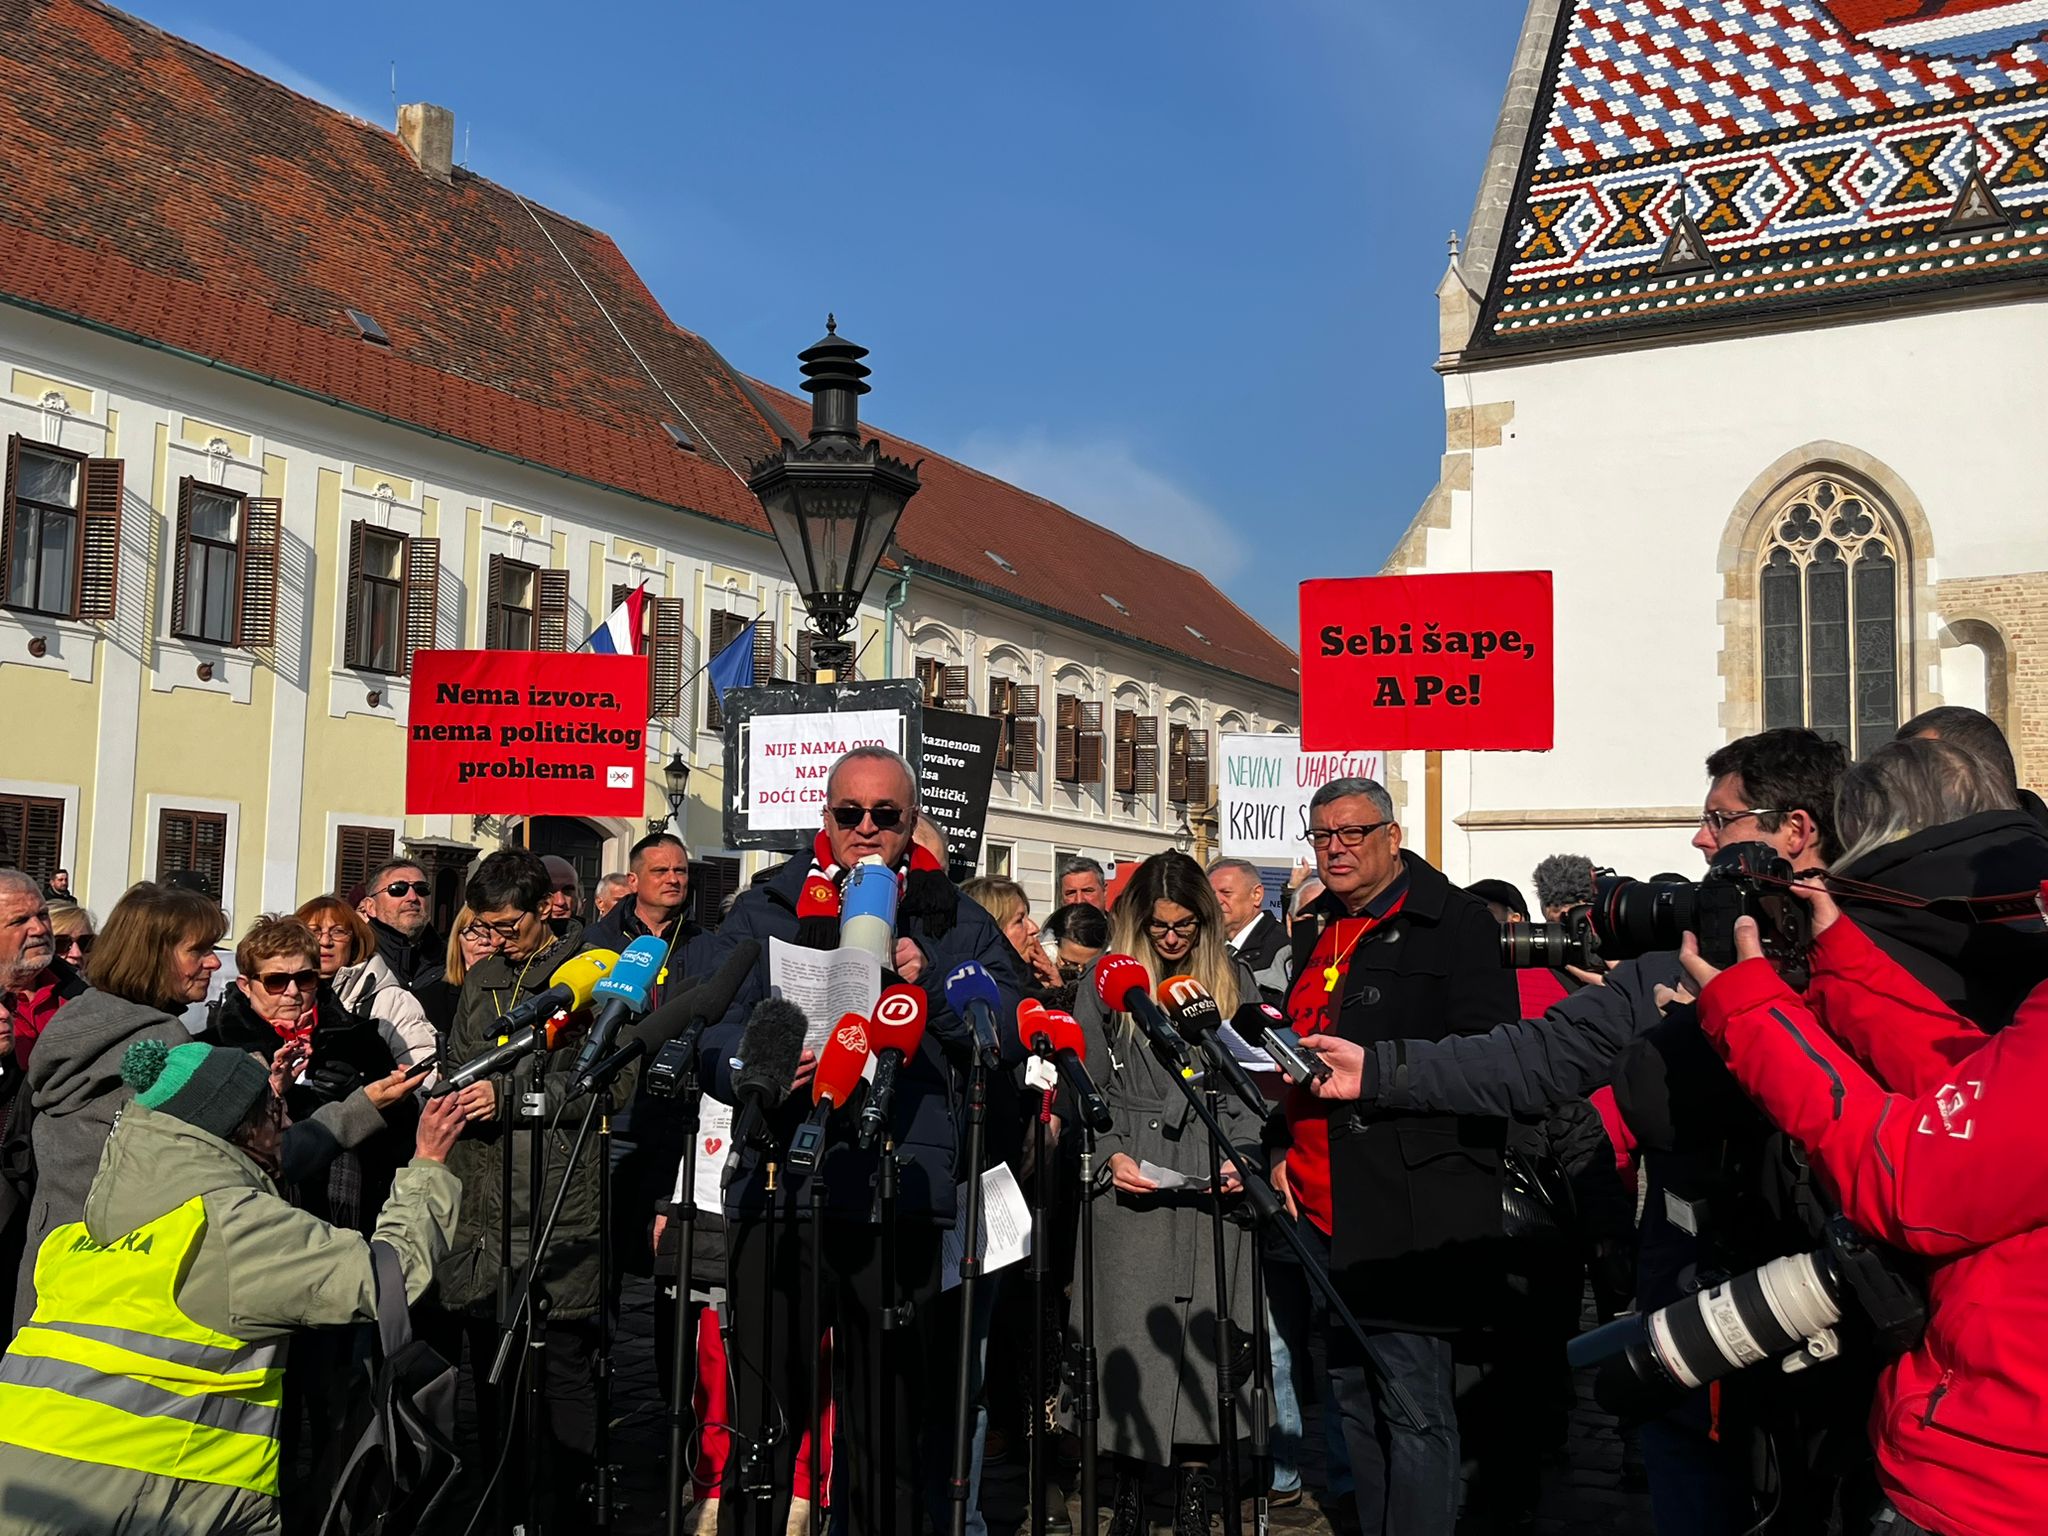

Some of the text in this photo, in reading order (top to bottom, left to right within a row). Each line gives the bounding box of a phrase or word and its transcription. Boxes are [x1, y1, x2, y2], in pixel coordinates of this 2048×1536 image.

[1320, 622, 1535, 660] Sebi šape,
[436, 683, 621, 712] Nema izvora,
[1373, 674, 1482, 707] A Pe!
[412, 721, 642, 751] nema političkog
[922, 733, 981, 753] kaznenom
[765, 743, 797, 758] NIJE
[801, 741, 847, 755] NAMA
[923, 753, 966, 768] ovakve
[458, 757, 595, 783] problema
[796, 766, 829, 780] NAP
[922, 768, 939, 781] isa
[1228, 755, 1281, 788] NEVINI
[759, 786, 829, 804] DOĆI ĆEM
[920, 803, 961, 819] e van i
[1230, 801, 1310, 841] KRIVCI S
[950, 824, 977, 838] neće
[1269, 900, 1283, 908] NE
[619, 983, 633, 992] FM
